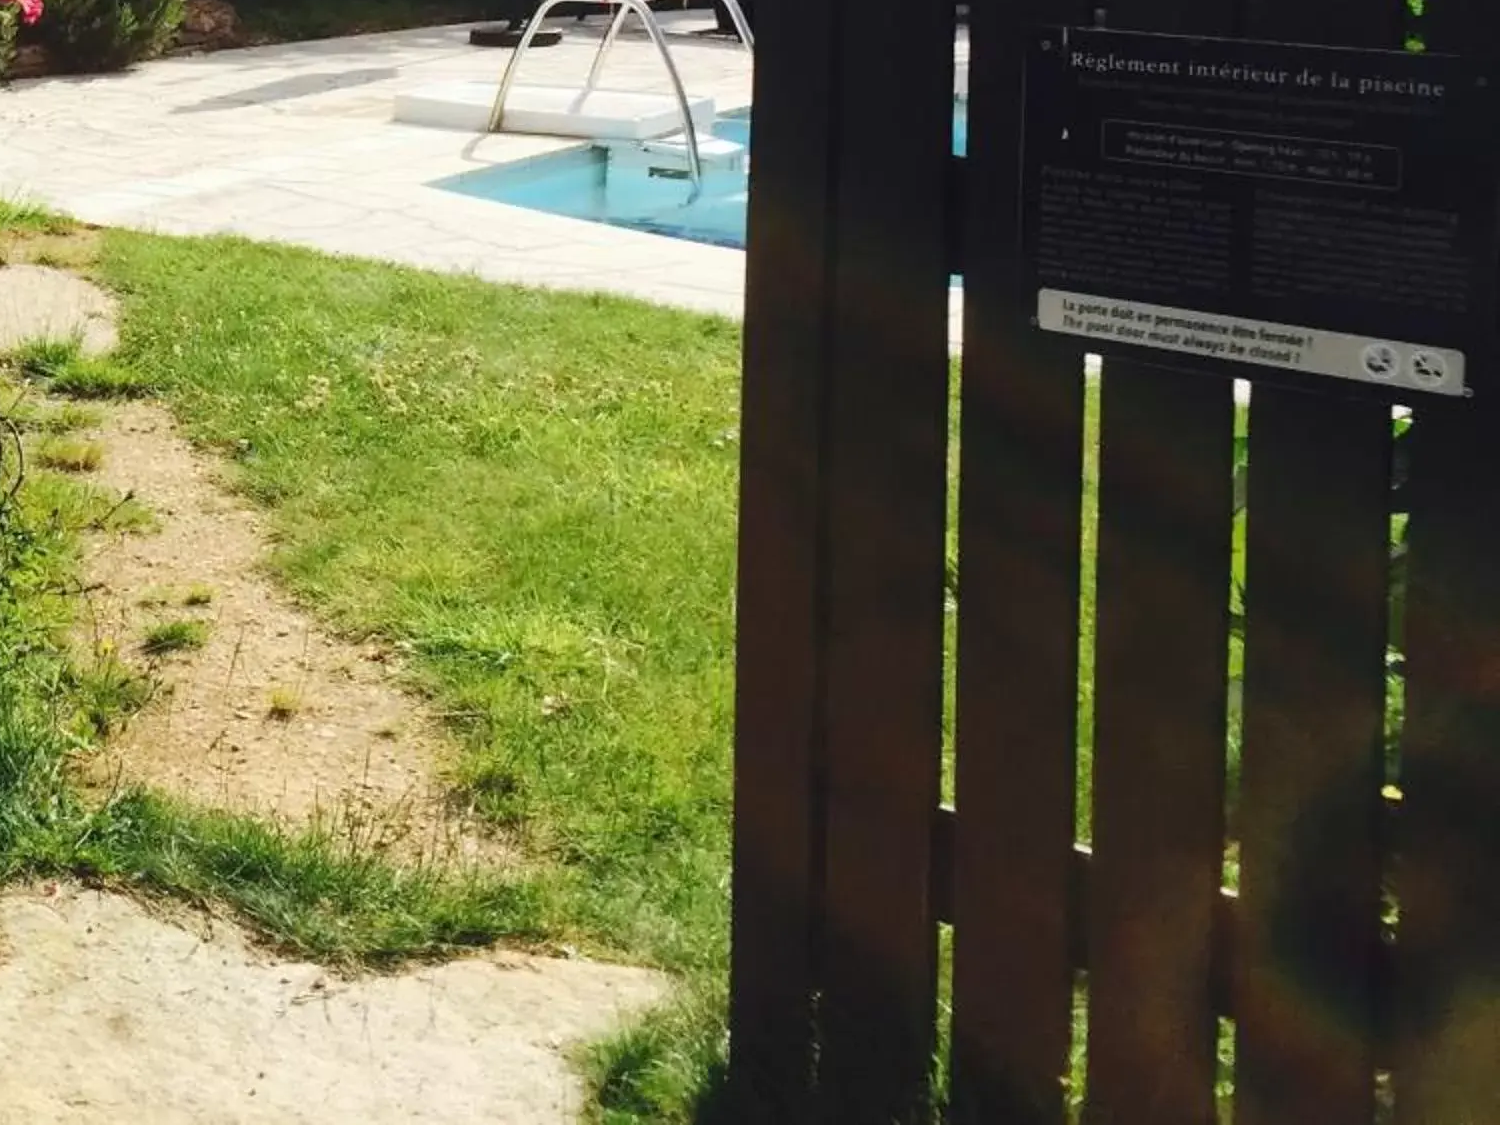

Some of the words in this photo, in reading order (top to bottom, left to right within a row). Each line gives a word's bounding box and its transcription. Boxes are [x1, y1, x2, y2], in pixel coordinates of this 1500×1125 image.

[1188, 59, 1289, 84] intérieur
[1296, 67, 1323, 87] de
[1331, 70, 1350, 89] la
[1358, 75, 1445, 97] piscine
[1062, 298, 1075, 311] La
[1077, 303, 1108, 316] porte
[1111, 306, 1134, 320] doit
[1154, 315, 1228, 334] permanence
[1062, 314, 1083, 328] The
[1086, 321, 1115, 333] pool
[1116, 325, 1145, 339] door
[1148, 331, 1181, 344] must
[1183, 333, 1225, 354] always
[1230, 341, 1245, 355] be
[1249, 346, 1290, 363] closed
